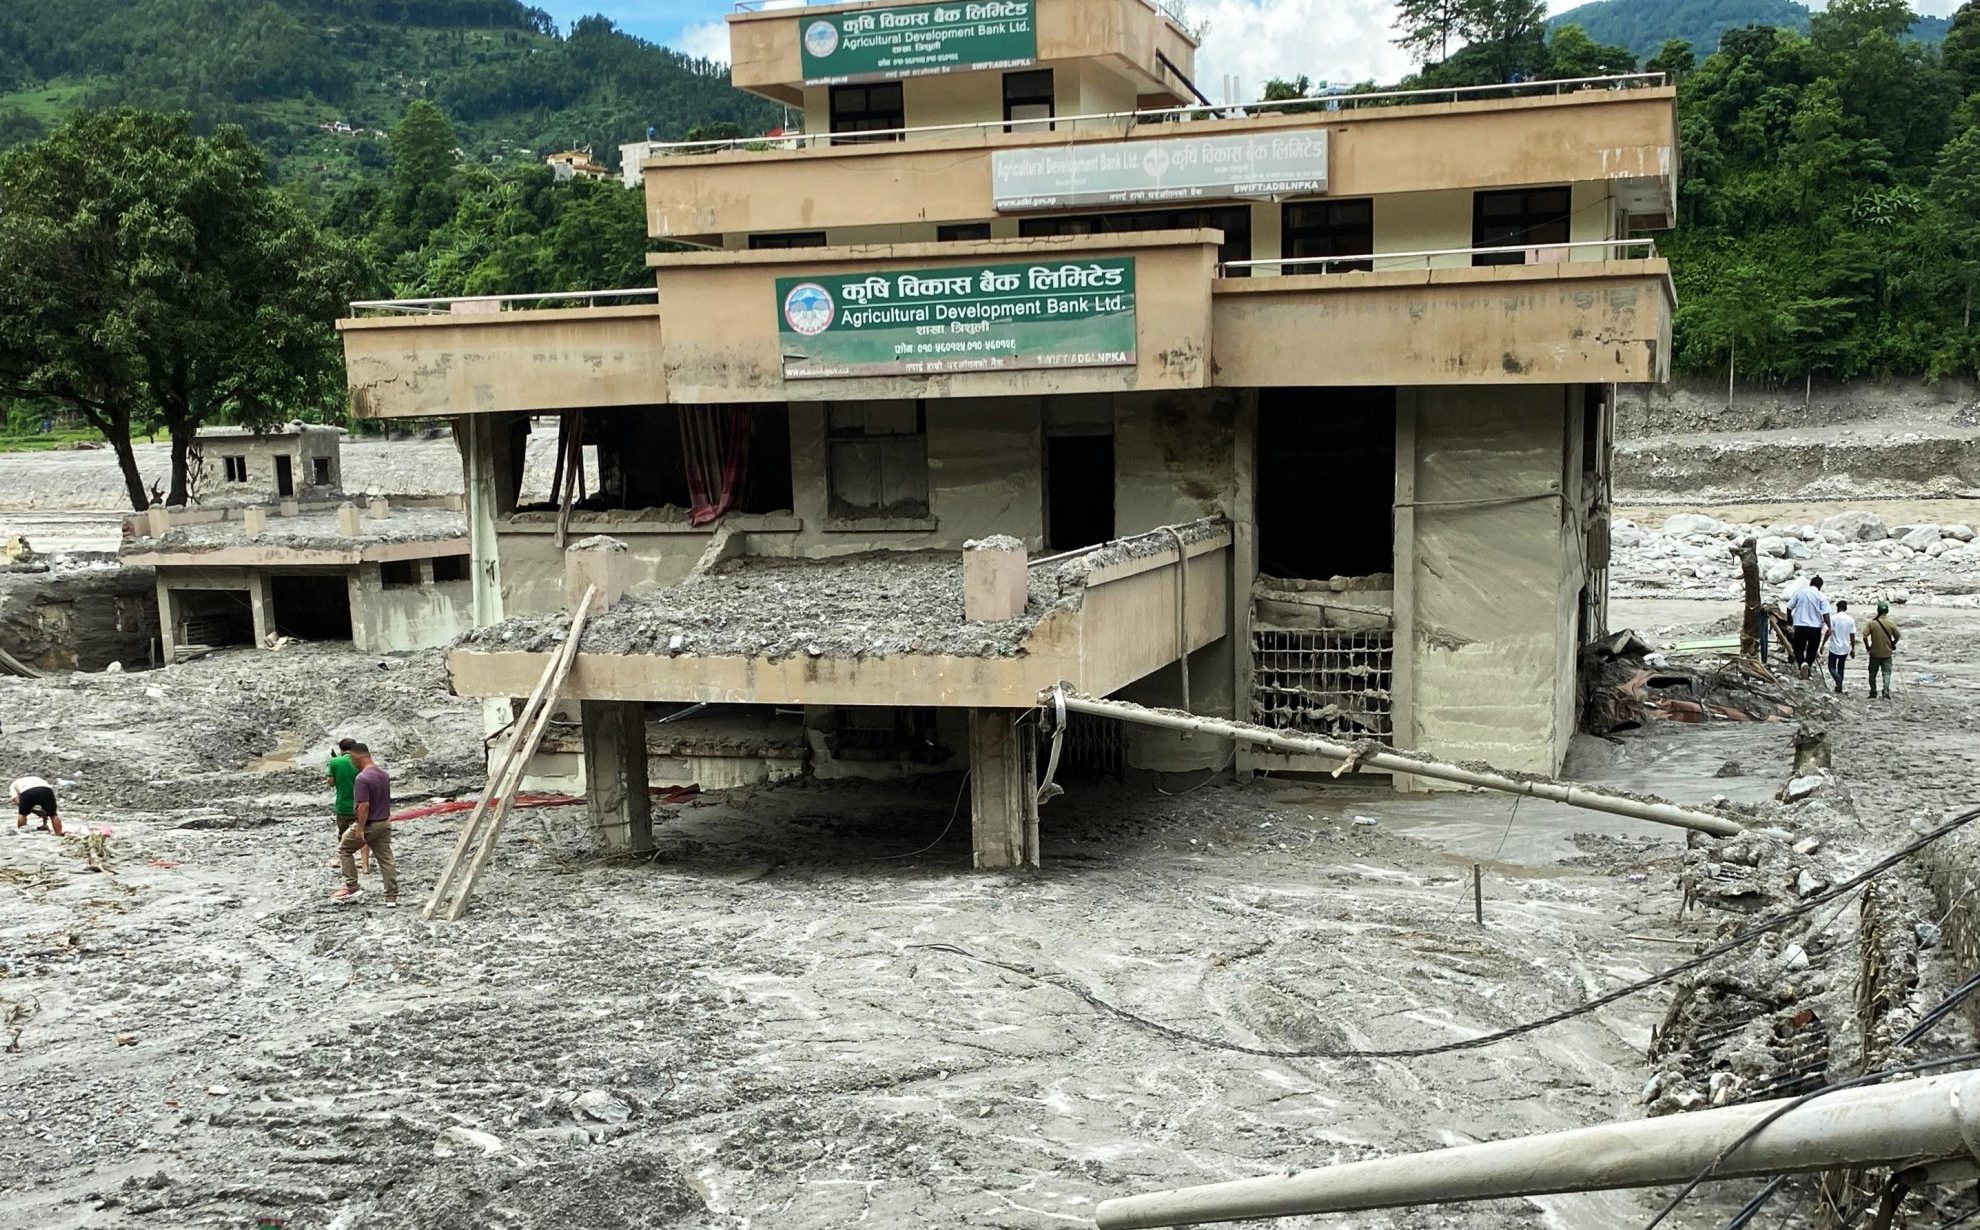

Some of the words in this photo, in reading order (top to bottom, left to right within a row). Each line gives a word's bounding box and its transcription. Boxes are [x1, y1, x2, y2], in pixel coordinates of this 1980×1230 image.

[880, 12, 930, 28] विकास
[966, 1, 1028, 20] लिमिटेड
[843, 33, 901, 50] Agricultural
[905, 26, 974, 42] Development
[978, 23, 1006, 36] Bank
[1009, 21, 1030, 33] Ltd.
[1202, 143, 1242, 165] विकास
[1272, 137, 1324, 160] लिमिटेड
[997, 158, 1045, 182] Agricultural
[1101, 152, 1123, 171] Bank
[1124, 151, 1139, 170] Ltd.
[842, 277, 892, 304] कृषि
[897, 275, 973, 297] विकास
[1028, 264, 1125, 290] लिमिटेड
[841, 306, 929, 328] Agricultural
[936, 300, 1041, 321] Development
[1047, 297, 1089, 313] Bank
[1095, 295, 1126, 312] Ltd.
